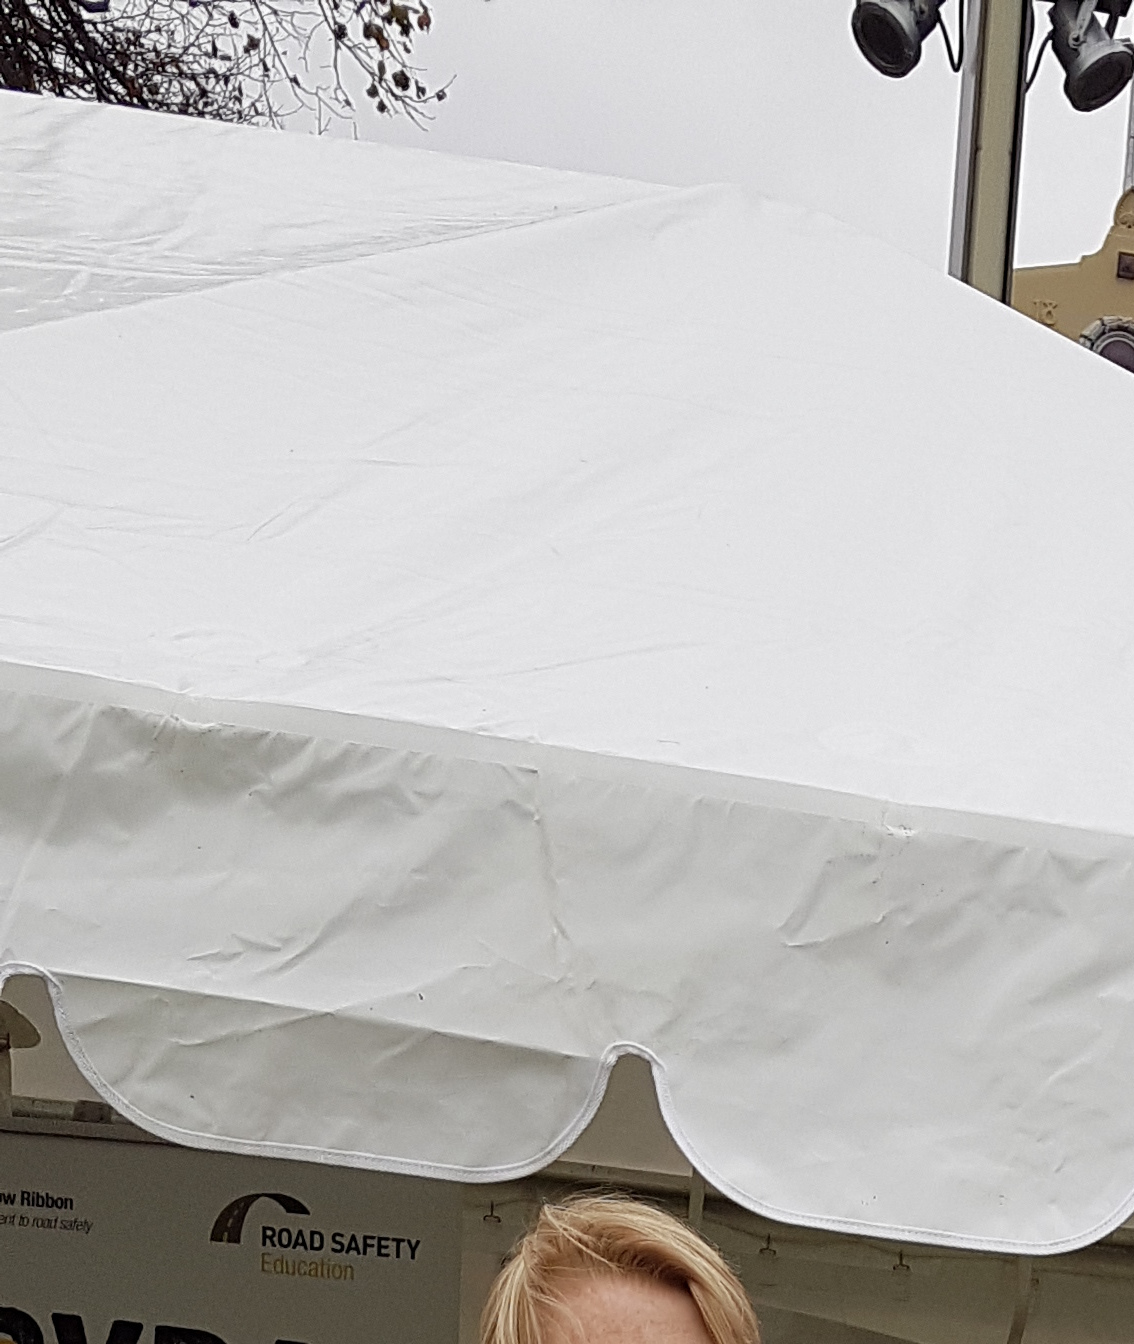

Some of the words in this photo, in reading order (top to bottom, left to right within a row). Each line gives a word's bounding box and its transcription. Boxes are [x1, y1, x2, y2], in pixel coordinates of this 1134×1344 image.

[20, 1190, 74, 1210] Ribbon
[18, 1215, 29, 1227] to
[32, 1217, 57, 1229] road
[60, 1219, 93, 1234] safety
[261, 1226, 325, 1251] ROAD
[331, 1233, 420, 1260] SAFETY
[261, 1253, 355, 1280] Education
